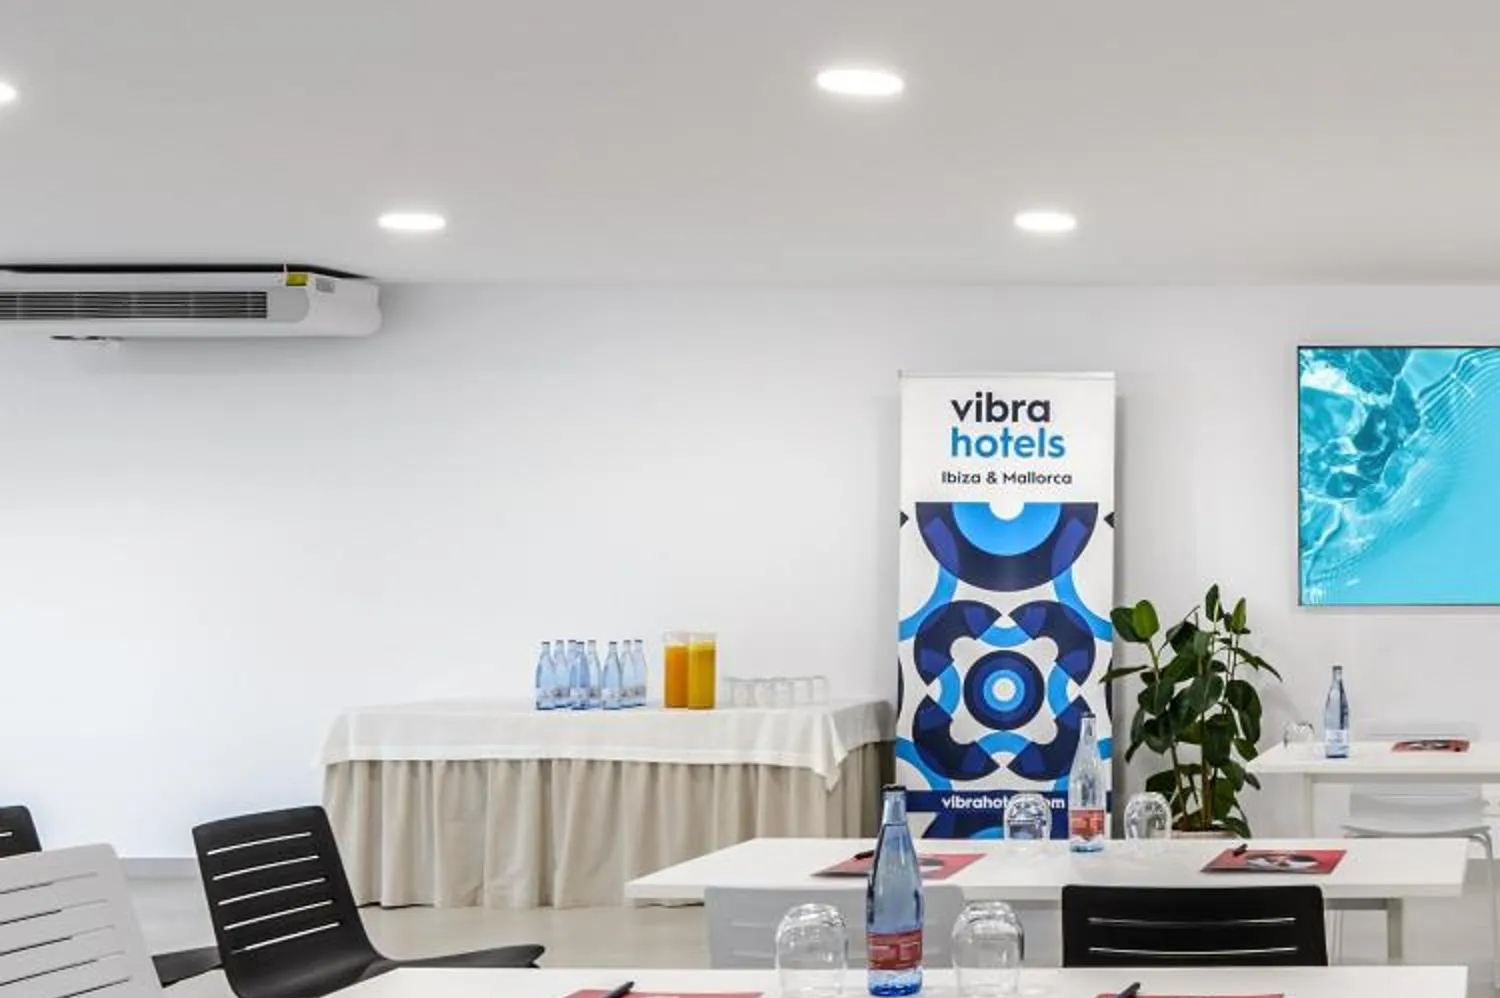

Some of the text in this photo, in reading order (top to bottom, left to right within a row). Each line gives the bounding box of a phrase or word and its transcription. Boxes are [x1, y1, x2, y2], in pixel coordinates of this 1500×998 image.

[950, 391, 1051, 423] vibra
[951, 426, 1066, 459] hotels
[941, 471, 1072, 485] Ibiza & Mallorca
